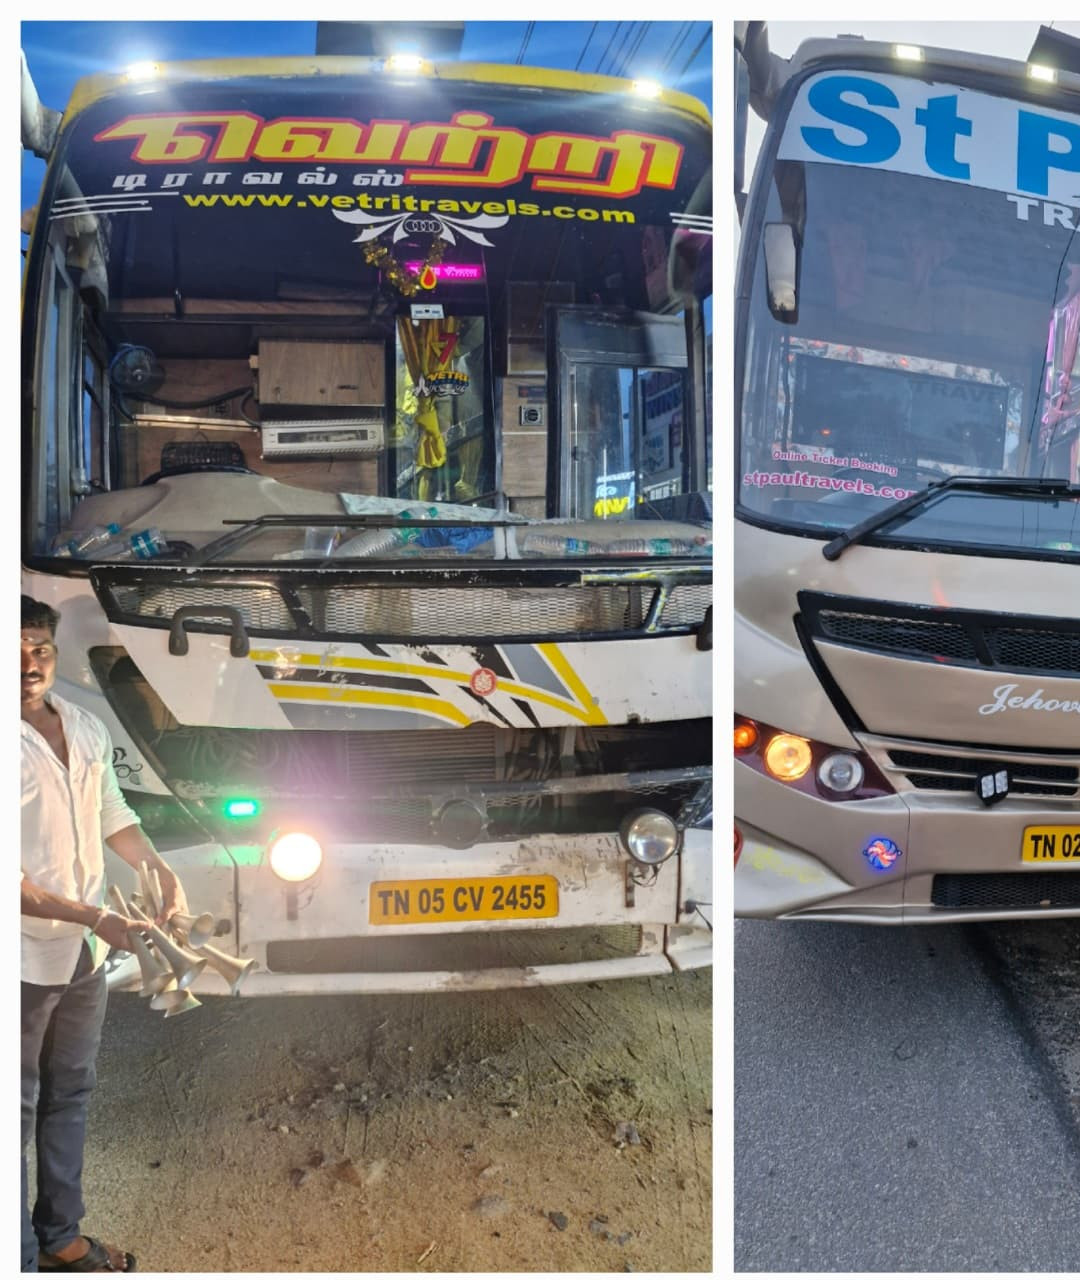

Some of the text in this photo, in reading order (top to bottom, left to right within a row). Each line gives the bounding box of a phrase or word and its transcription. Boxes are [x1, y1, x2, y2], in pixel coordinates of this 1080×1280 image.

[801, 76, 973, 181] St
[95, 110, 685, 198] வெற்றி
[183, 194, 636, 224] www.vetritravels.com
[772, 450, 898, 477] Online Ticket Booking
[1031, 834, 1056, 858] TN
[378, 885, 546, 916] TN 05 CV 2455
